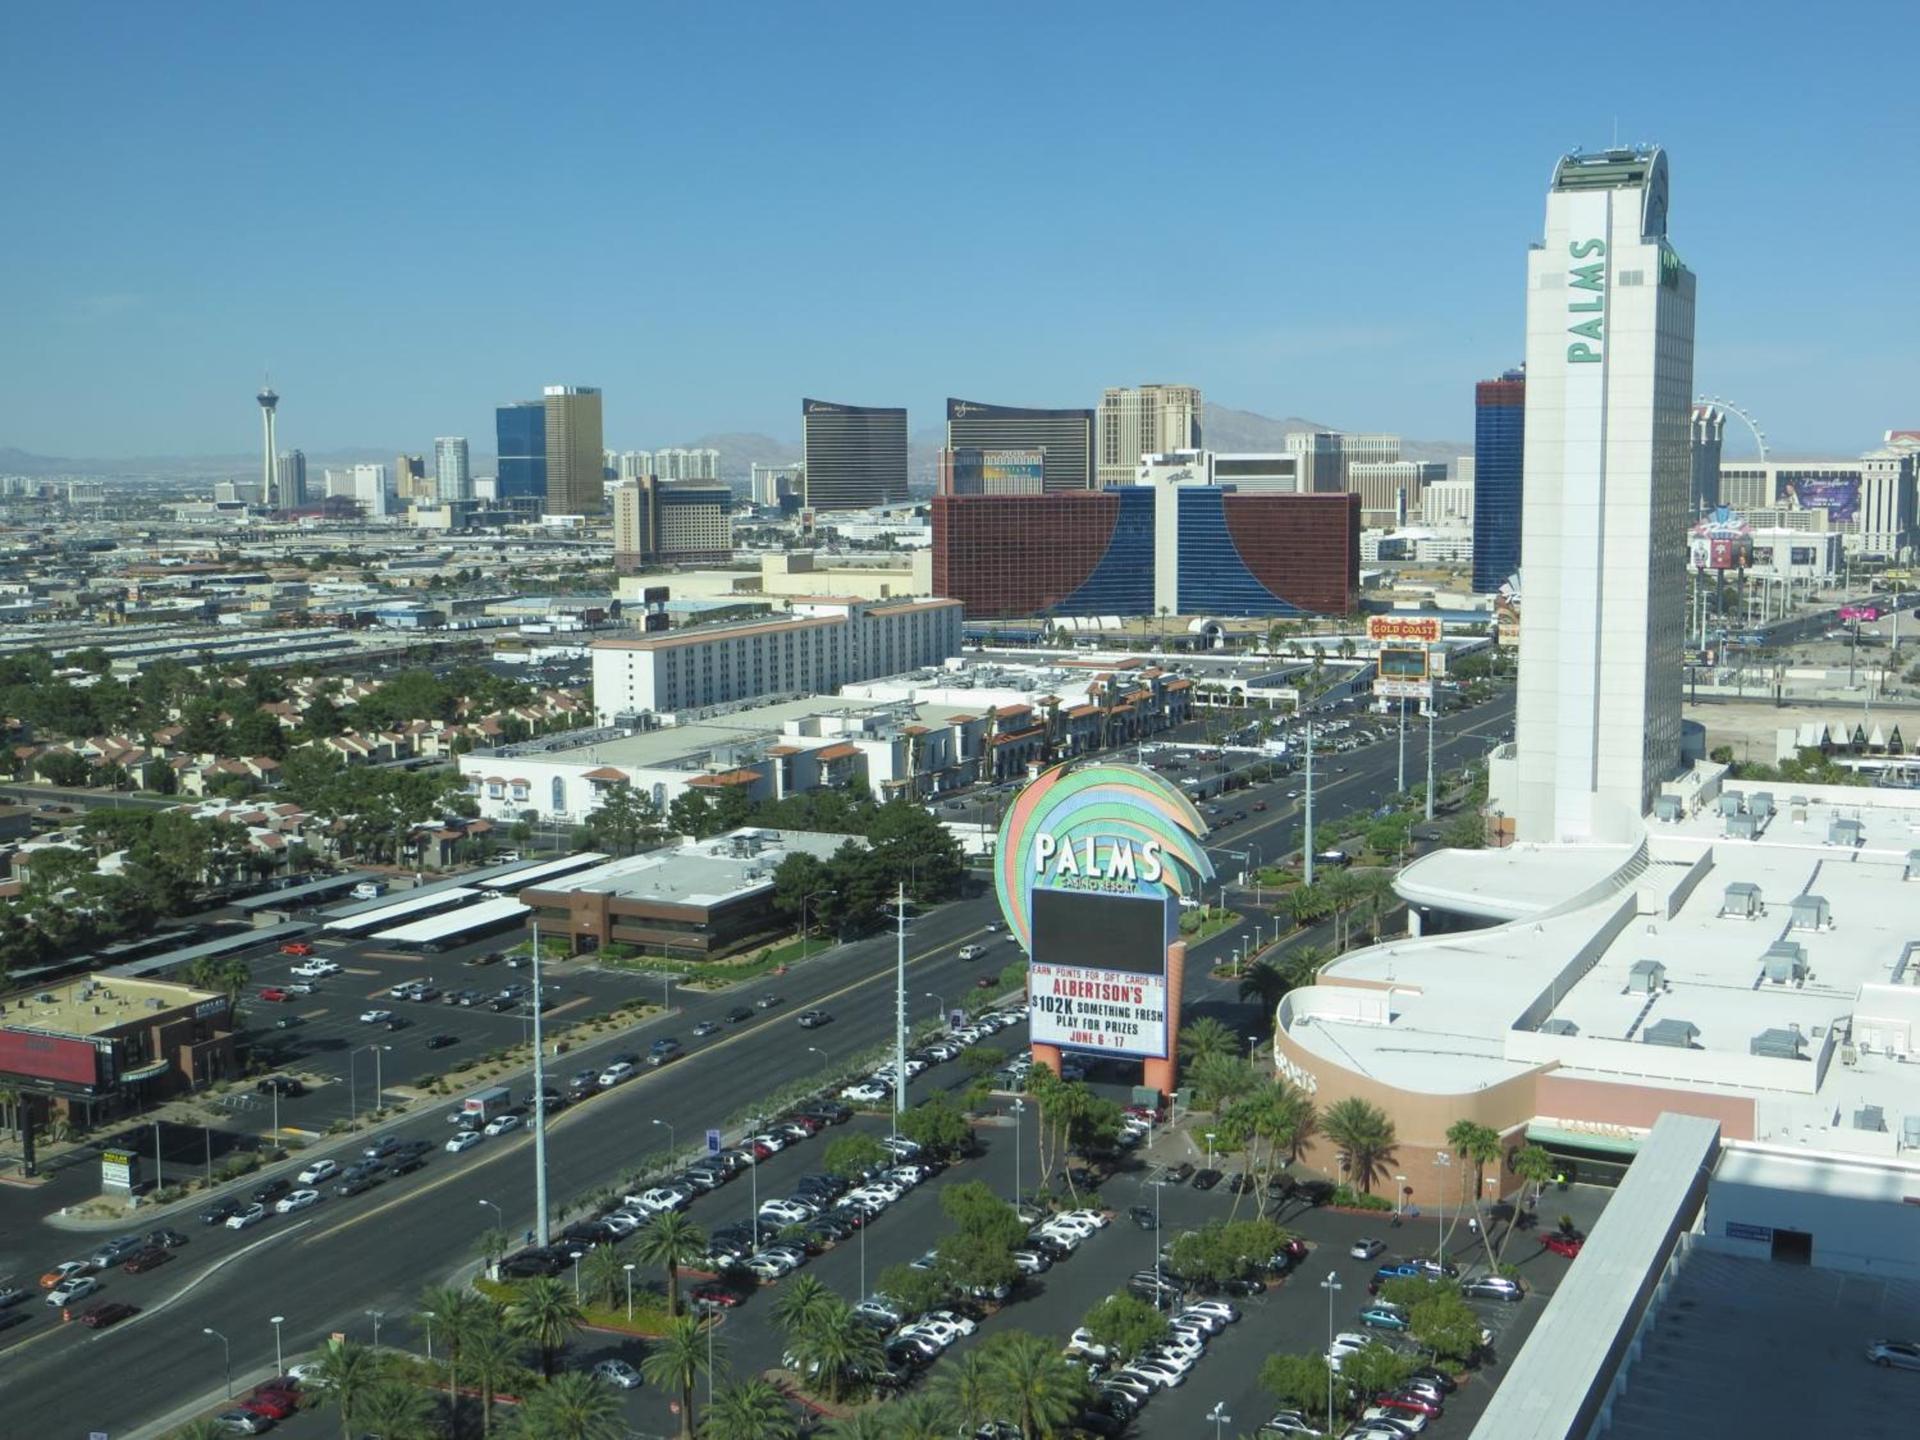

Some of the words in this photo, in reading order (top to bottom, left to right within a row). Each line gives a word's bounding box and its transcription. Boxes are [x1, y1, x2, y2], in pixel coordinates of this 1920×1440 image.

[1567, 238, 1606, 363] PALMS
[1373, 624, 1400, 634] GOLD
[1402, 625, 1434, 634] COAST
[1035, 832, 1163, 883] PALMS
[1032, 965, 1052, 976] EARN
[1056, 967, 1081, 979] POINTS
[1085, 969, 1100, 981] FOR
[1125, 974, 1150, 986] CARDS
[1053, 978, 1143, 1005] ALBERTSON'S
[1032, 994, 1073, 1015] $102K
[1077, 1002, 1131, 1019] SOMETHING
[1135, 1007, 1164, 1022] FRESH
[1056, 1015, 1078, 1029] PLAY
[1083, 1018, 1100, 1031] FOR
[1105, 1020, 1139, 1035] PRIZES
[1069, 1031, 1093, 1044] JUNE
[1097, 1034, 1104, 1046] 6
[1115, 1036, 1125, 1047] 17
